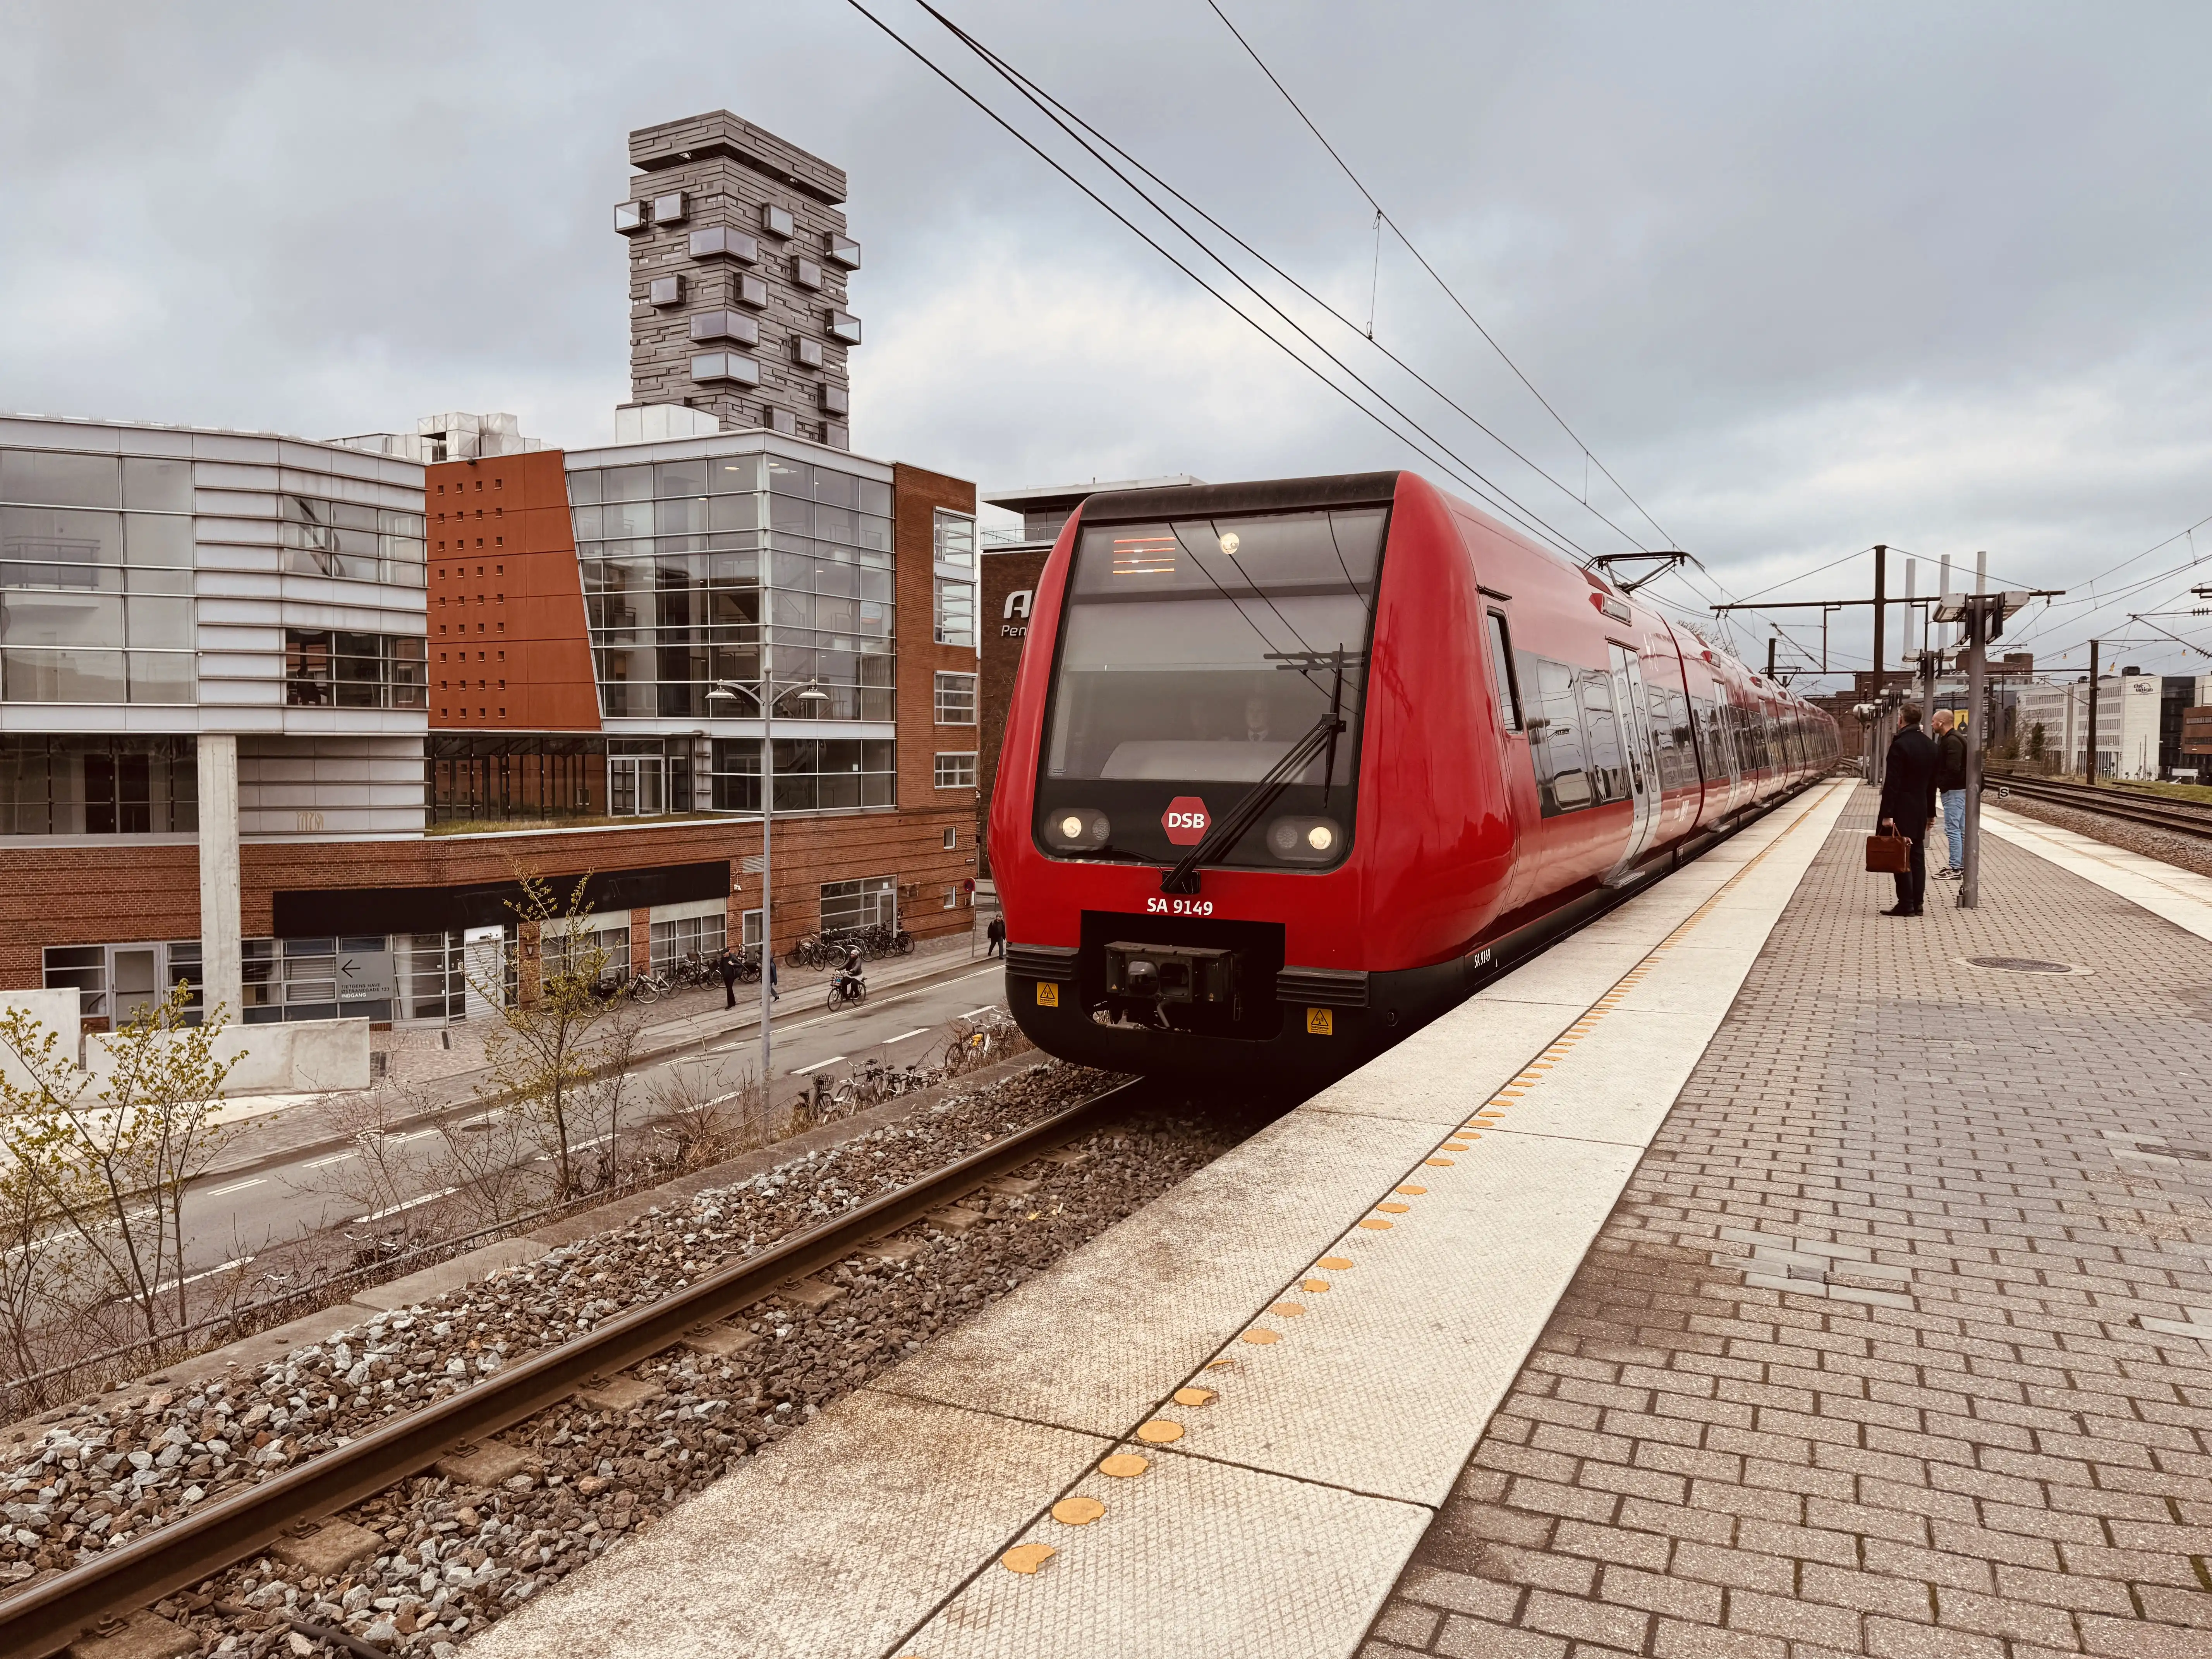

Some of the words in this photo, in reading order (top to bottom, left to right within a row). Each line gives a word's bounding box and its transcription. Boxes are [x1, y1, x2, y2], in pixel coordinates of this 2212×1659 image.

[1003, 590, 1032, 619] A
[1001, 625, 1027, 637] Pen
[2001, 788, 2008, 797] S
[1168, 812, 1204, 828] DSB
[1147, 898, 1168, 913] SA
[1173, 899, 1213, 916] 9149
[1474, 953, 1480, 969] SA
